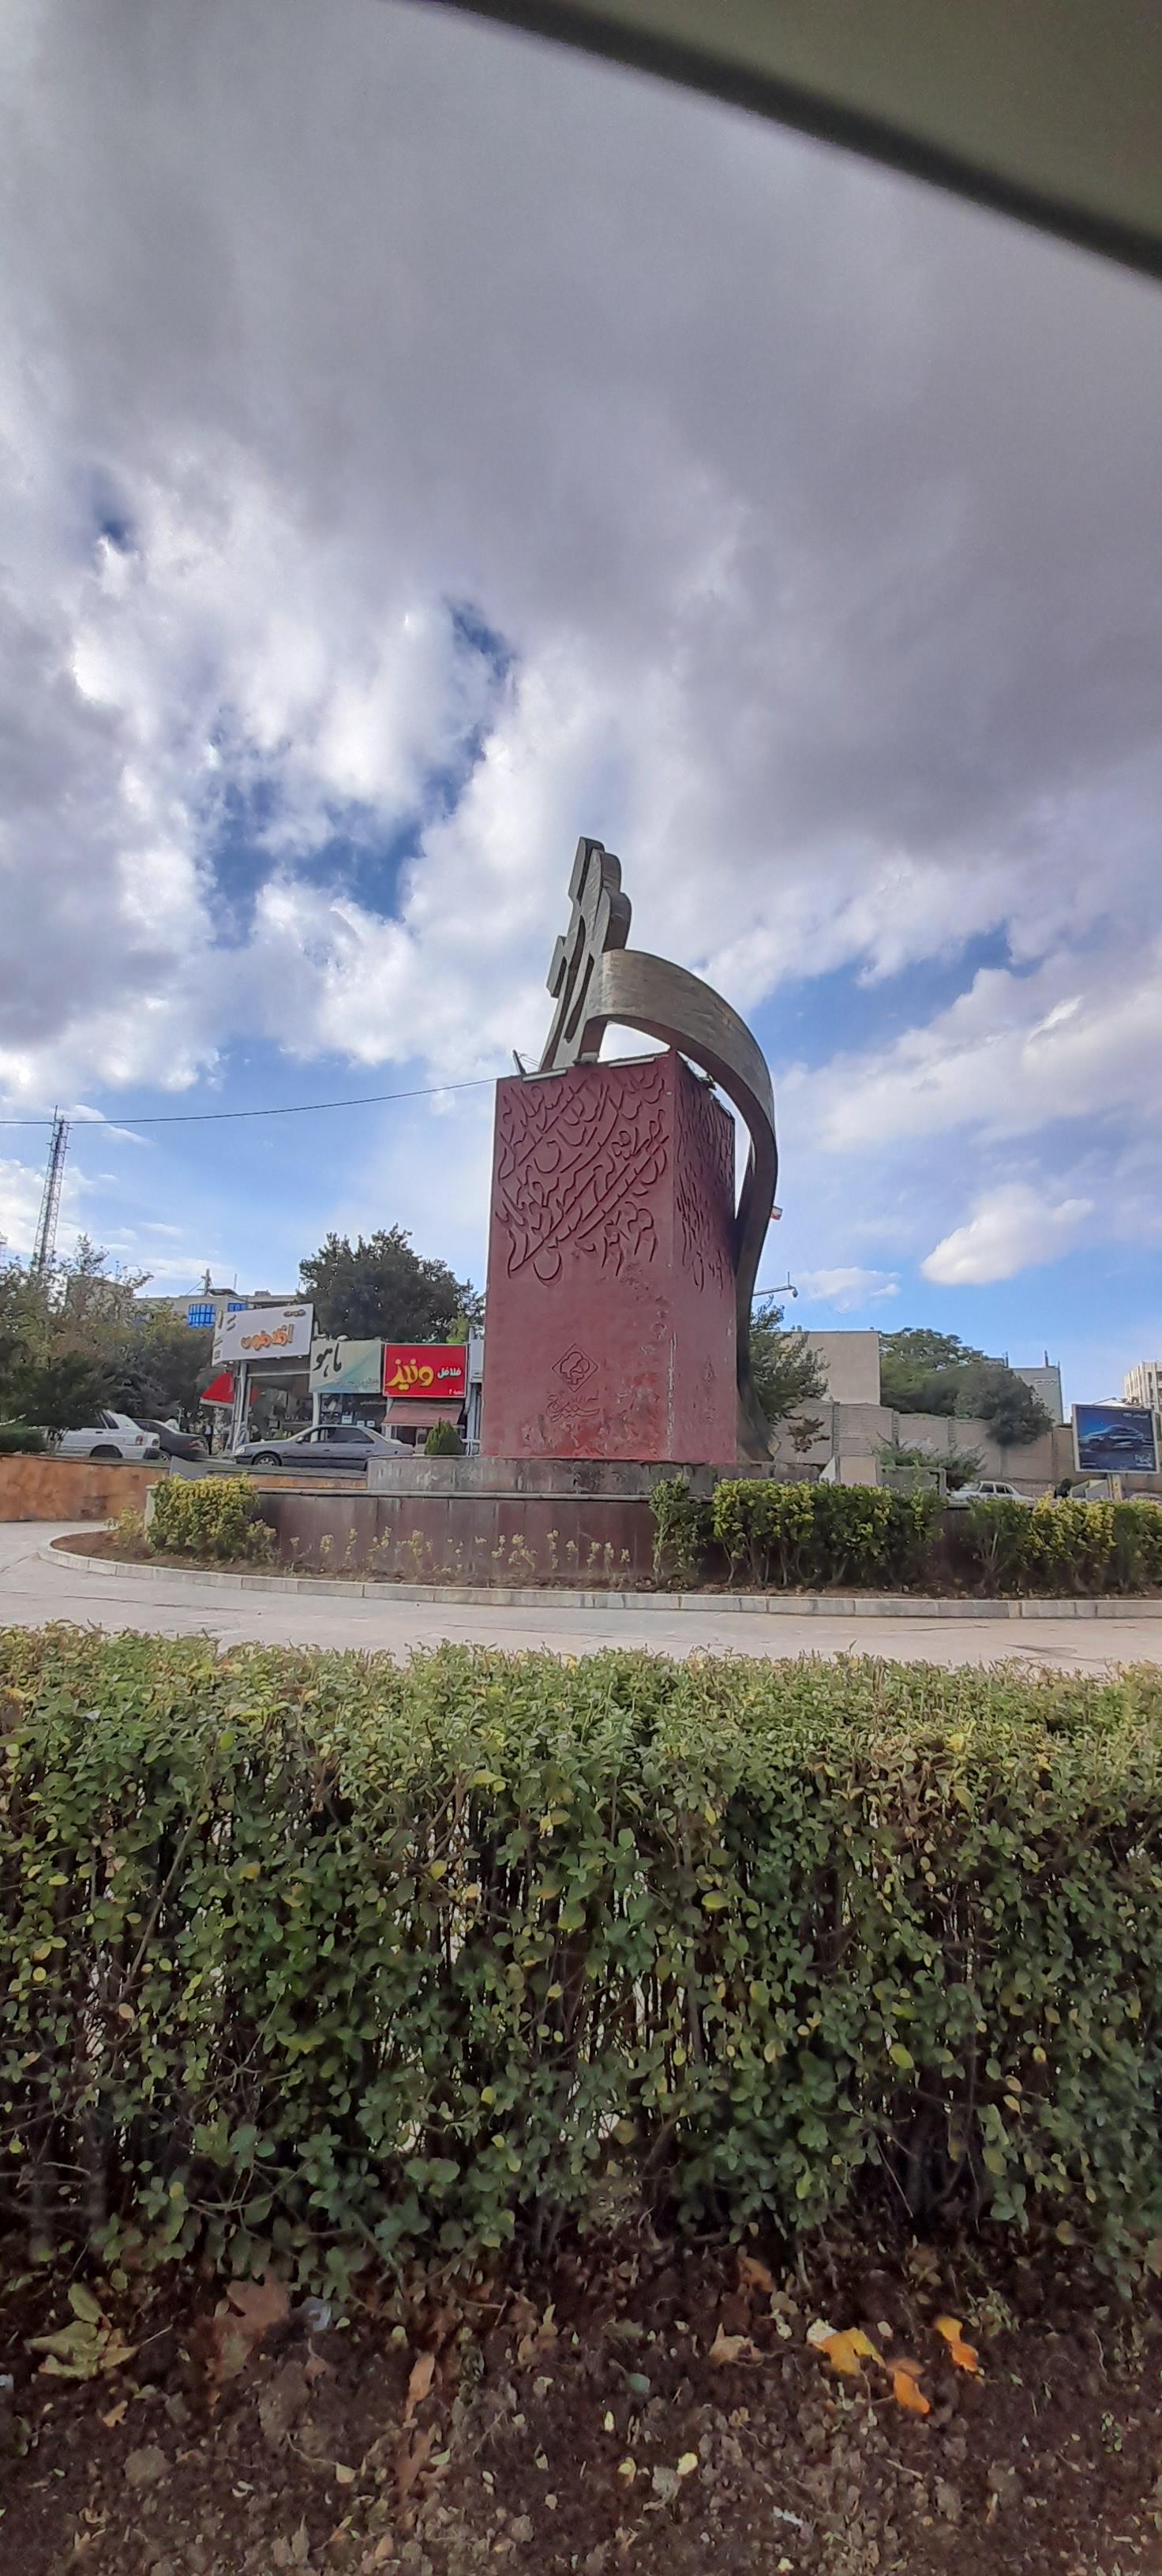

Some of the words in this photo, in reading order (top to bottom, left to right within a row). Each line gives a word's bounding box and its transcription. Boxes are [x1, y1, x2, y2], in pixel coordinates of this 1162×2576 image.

[313, 1342, 342, 1377] ماهو
[385, 1357, 435, 1391] ونیز
[437, 1366, 462, 1379] فلافل
